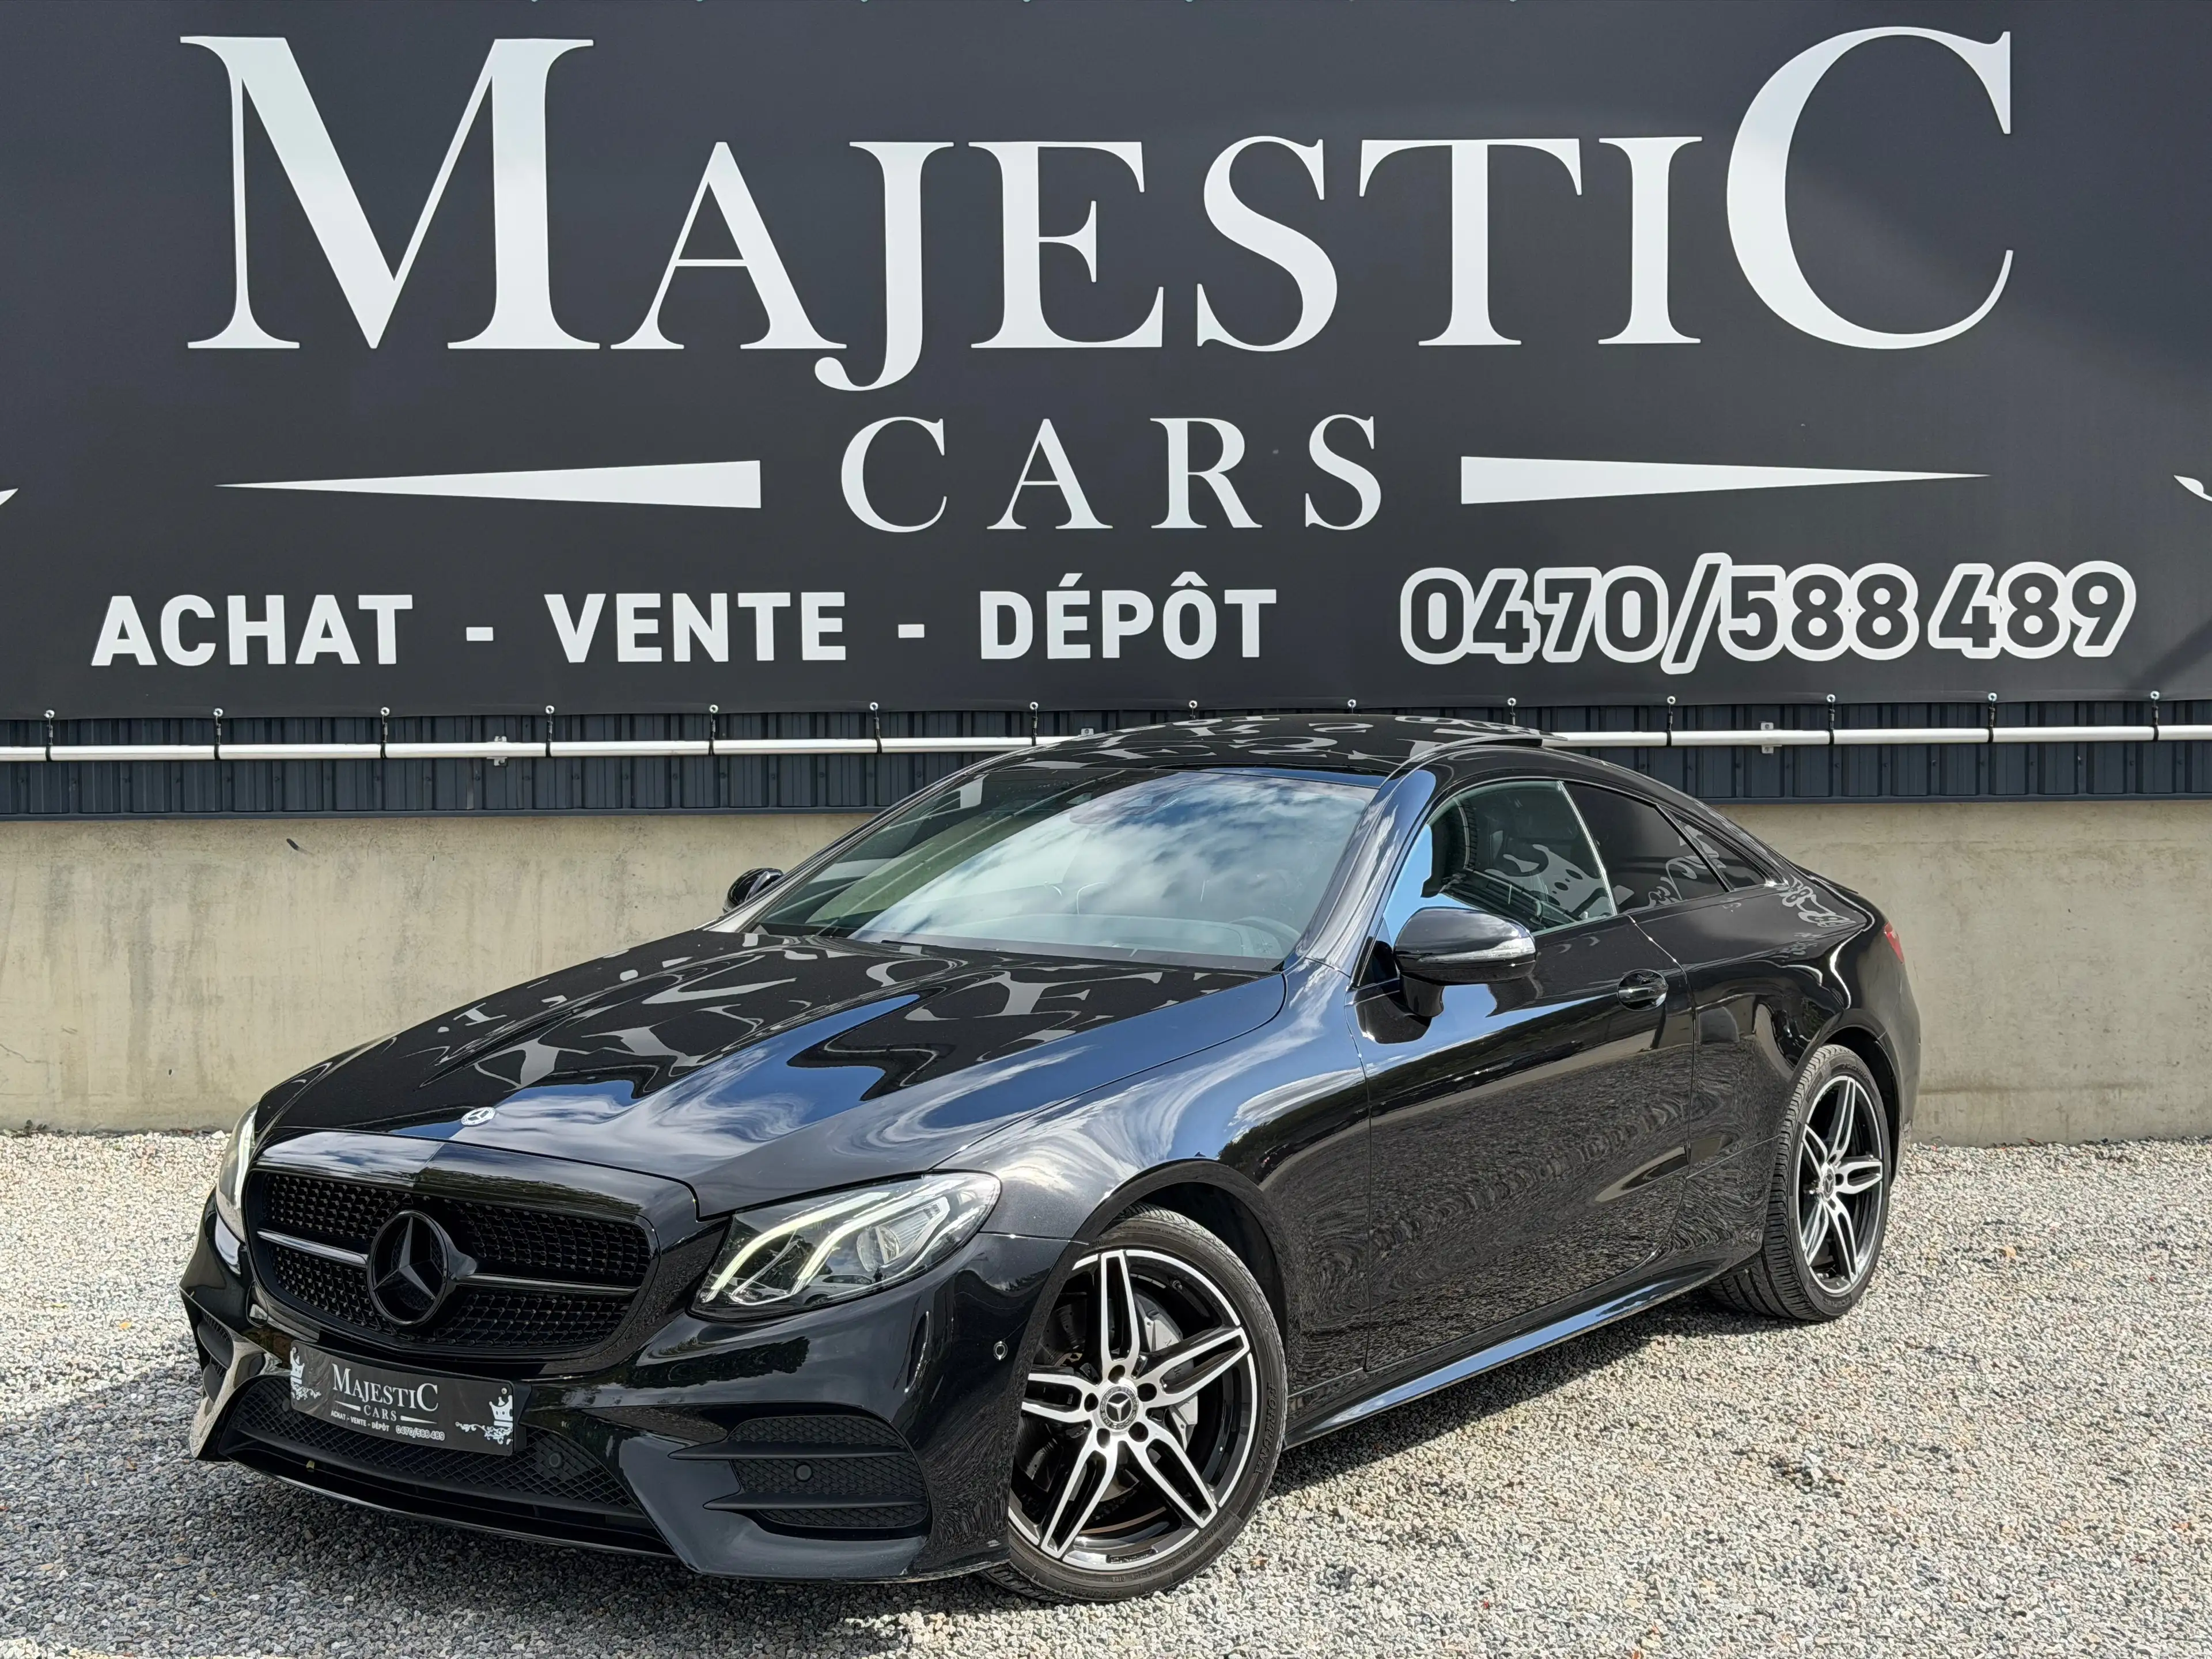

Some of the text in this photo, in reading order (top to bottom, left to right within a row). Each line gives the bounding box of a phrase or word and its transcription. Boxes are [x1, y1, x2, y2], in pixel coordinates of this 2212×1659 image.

[180, 26, 2013, 391] MAJESTIC
[841, 414, 1381, 533] CARS
[91, 594, 413, 666] ACHAT
[544, 592, 846, 663] VENTE
[980, 571, 1277, 660] DÉPÔT
[1400, 552, 2137, 675] 0470/588 489
[331, 1410, 346, 1421] ACHAT
[350, 1416, 367, 1427] VENTE
[372, 1421, 390, 1432] DÉPÔT
[332, 1363, 439, 1412] MAJESTIC
[363, 1404, 397, 1421] CARS
